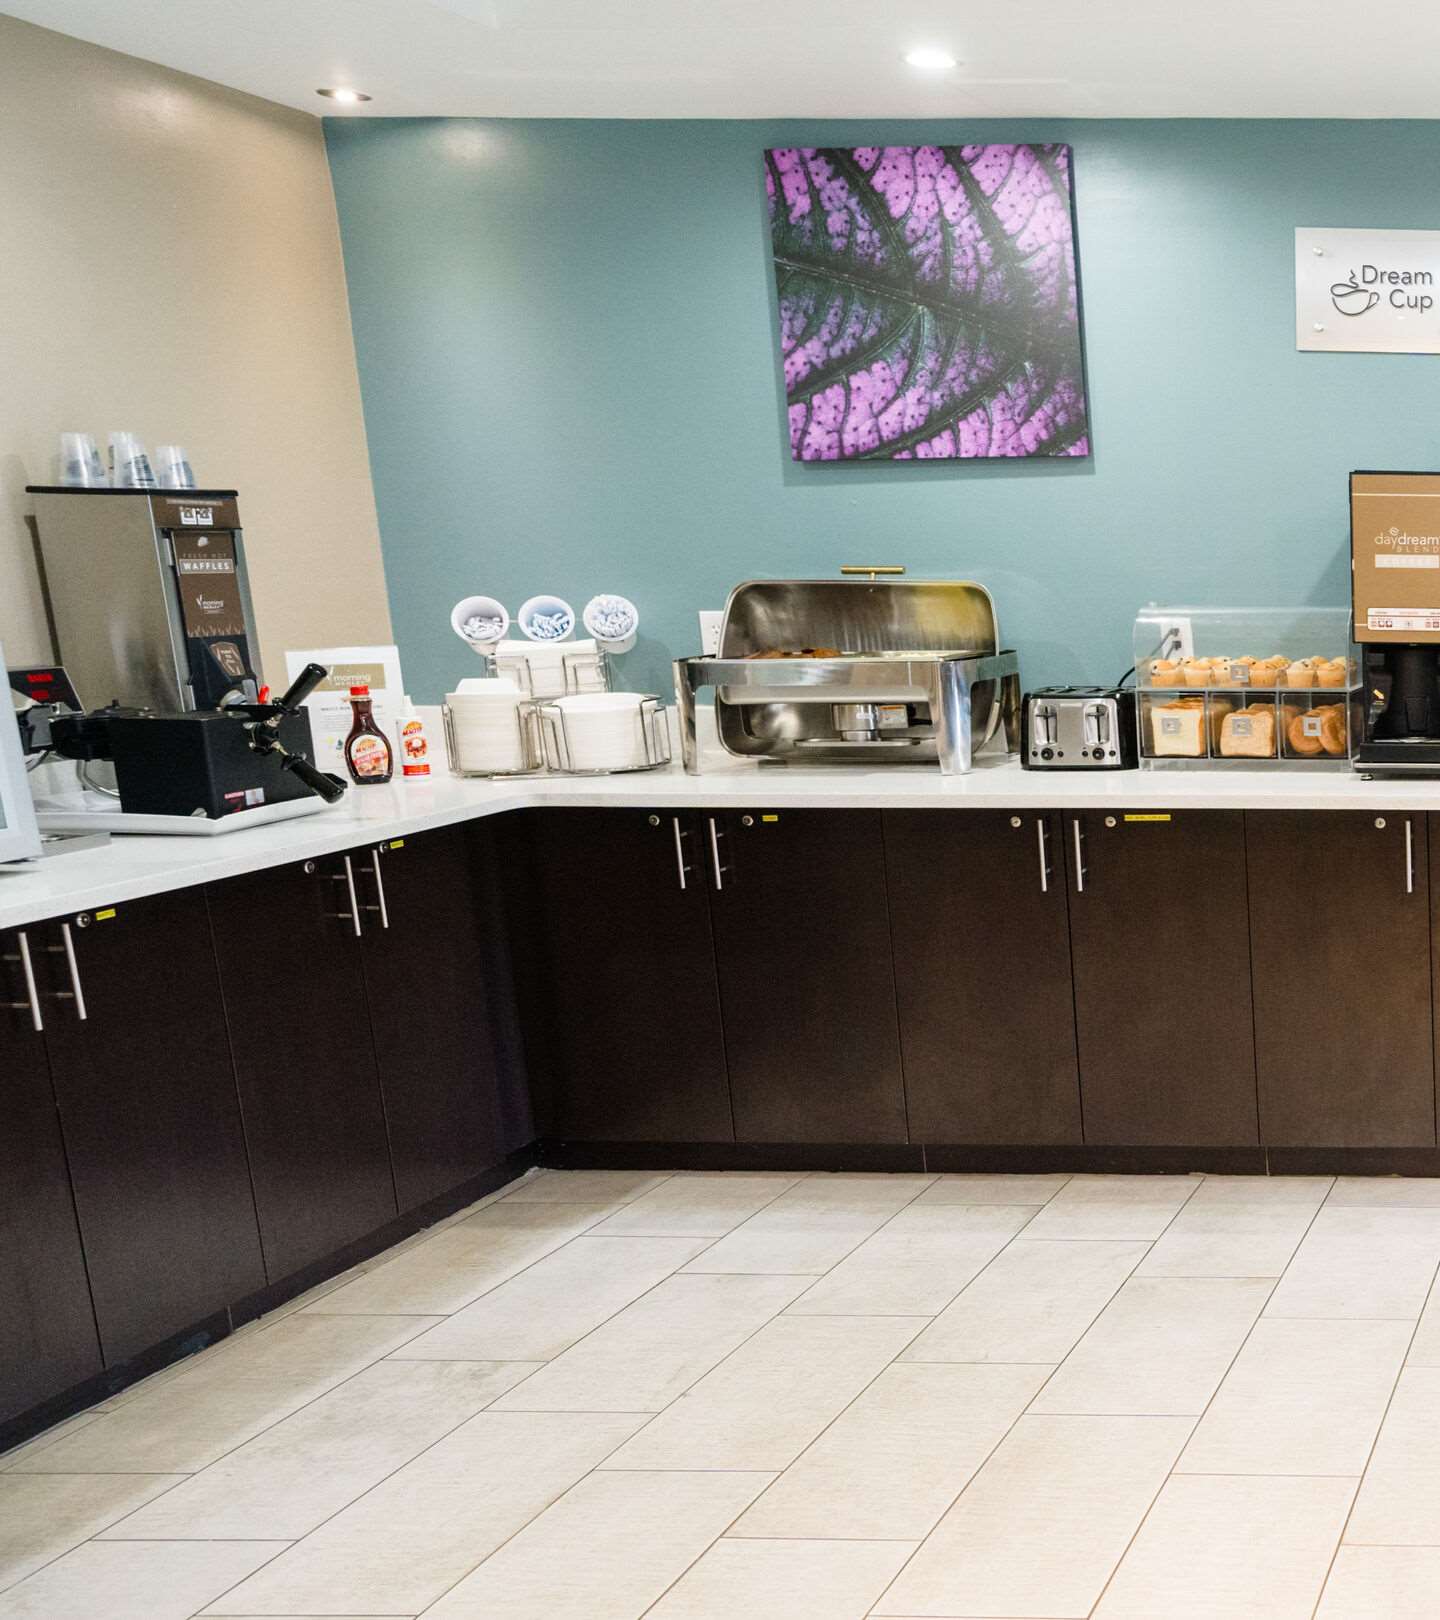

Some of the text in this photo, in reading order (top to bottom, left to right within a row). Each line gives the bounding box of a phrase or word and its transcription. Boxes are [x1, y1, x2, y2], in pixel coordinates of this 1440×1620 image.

[1362, 264, 1433, 285] Dream
[1389, 288, 1433, 314] Cup
[1374, 532, 1440, 550] daydream
[1396, 545, 1440, 553] BLEND
[183, 562, 230, 570] WAFFLES
